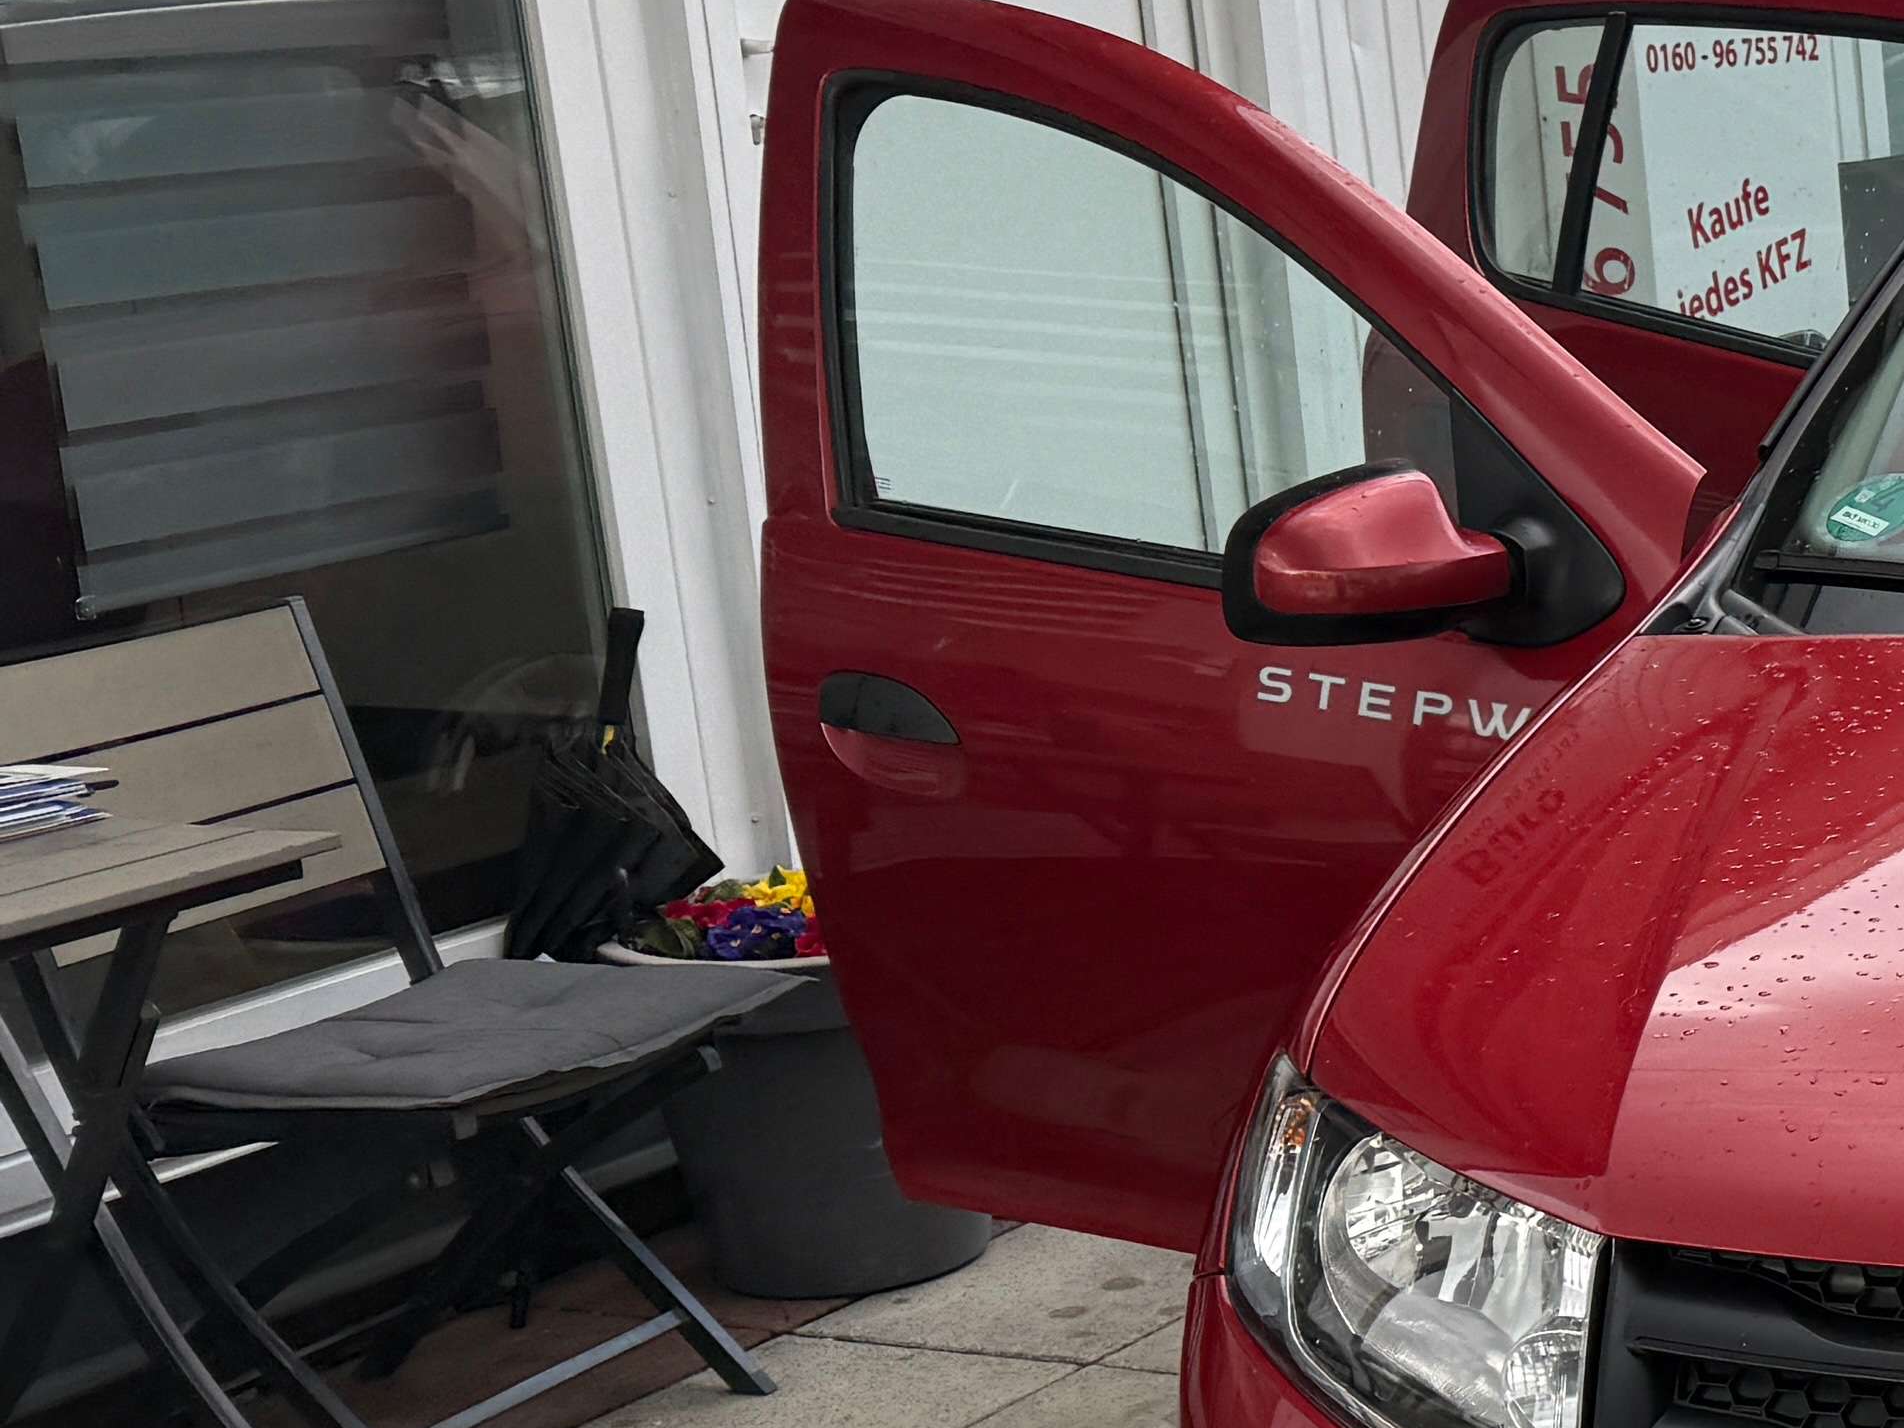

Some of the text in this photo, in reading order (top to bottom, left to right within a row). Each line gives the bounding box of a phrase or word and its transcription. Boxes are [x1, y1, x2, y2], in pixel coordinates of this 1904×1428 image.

[1646, 41, 1696, 73] 0160
[1712, 38, 1738, 69] 96
[1741, 36, 1778, 66] 755
[1782, 34, 1819, 63] 742
[1687, 177, 1770, 249] Kaufe
[1756, 227, 1812, 290] KFZ
[1257, 666, 1532, 741] STEPW
